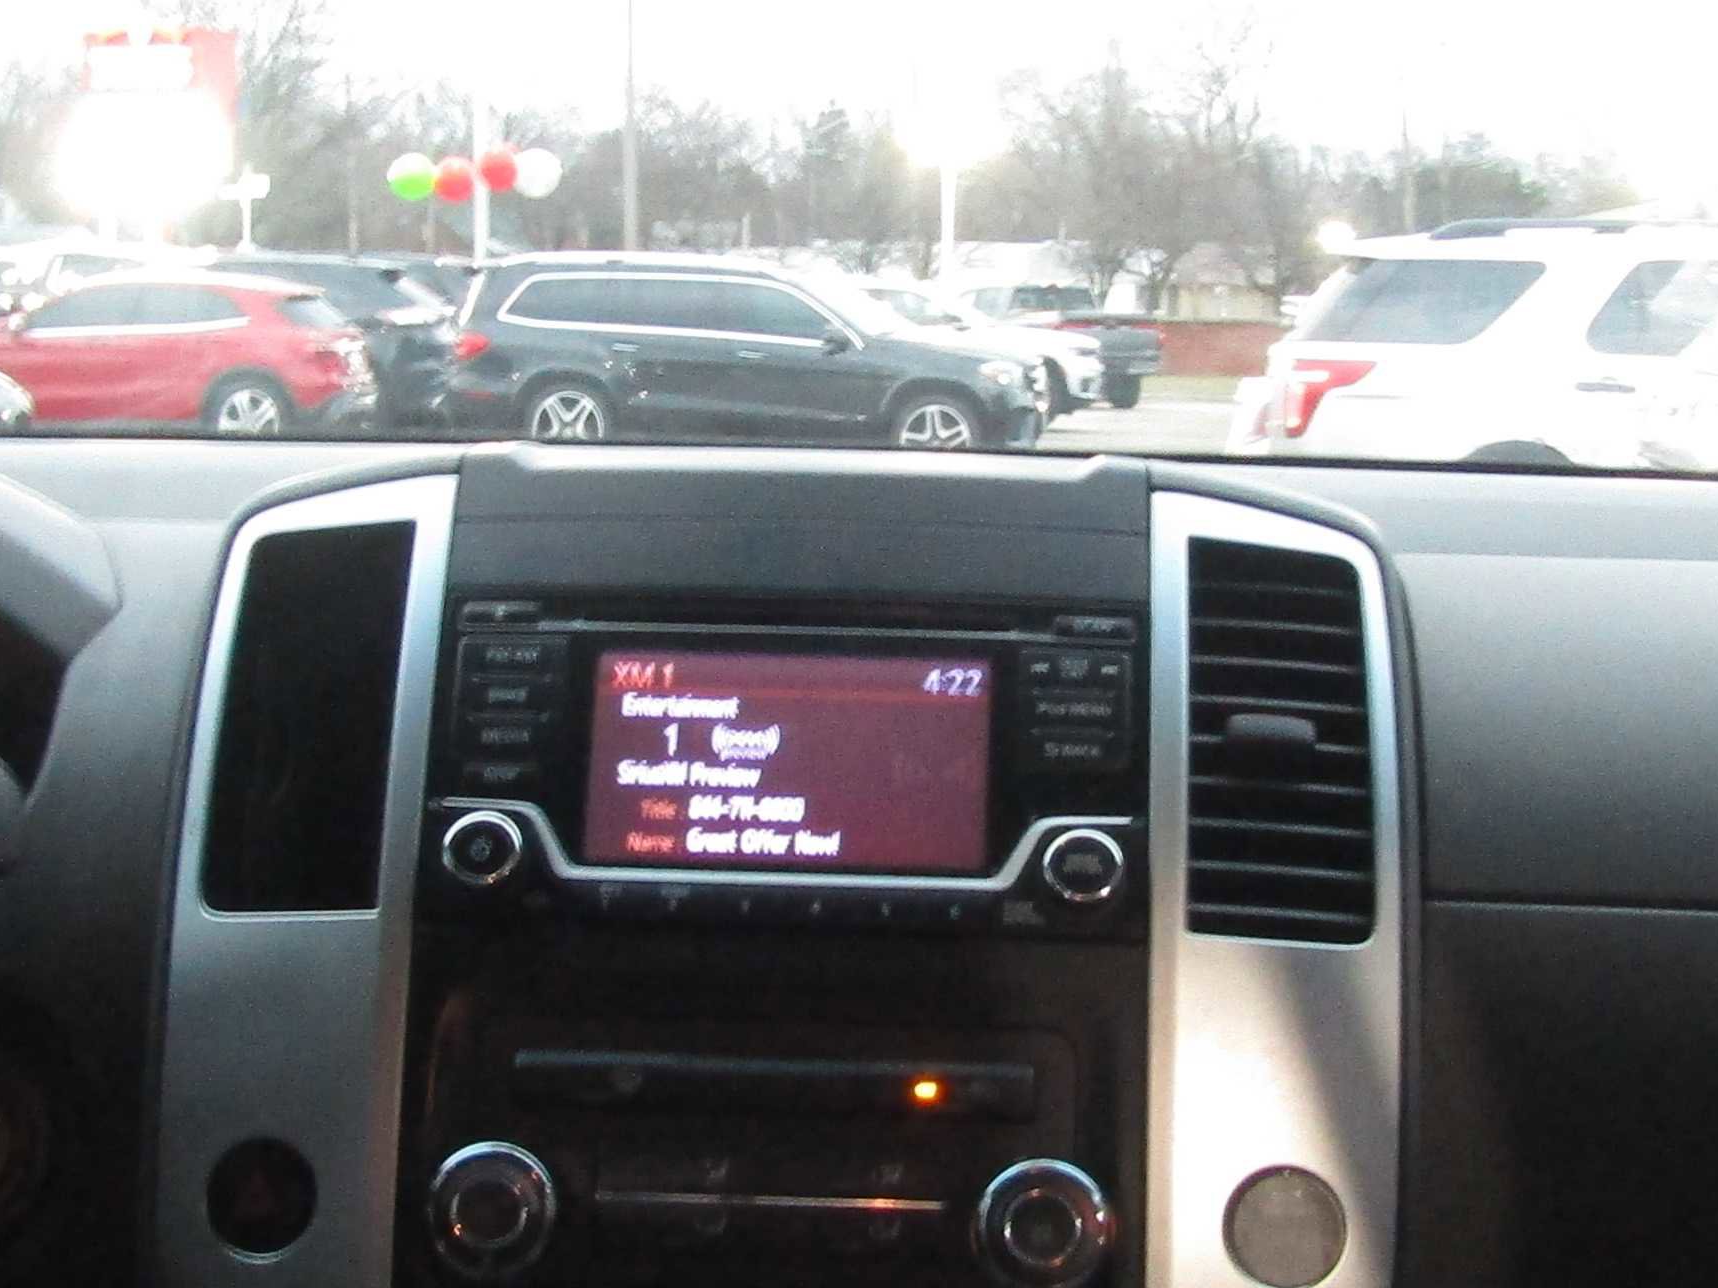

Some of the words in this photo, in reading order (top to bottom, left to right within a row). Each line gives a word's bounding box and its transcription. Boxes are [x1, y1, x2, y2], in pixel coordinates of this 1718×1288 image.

[613, 661, 655, 689] XM
[923, 668, 983, 697] 4:22
[621, 692, 740, 719] Entertainment
[664, 722, 679, 757] 1
[689, 762, 761, 788] Preview
[686, 826, 738, 853] Great
[740, 828, 791, 855] Offer
